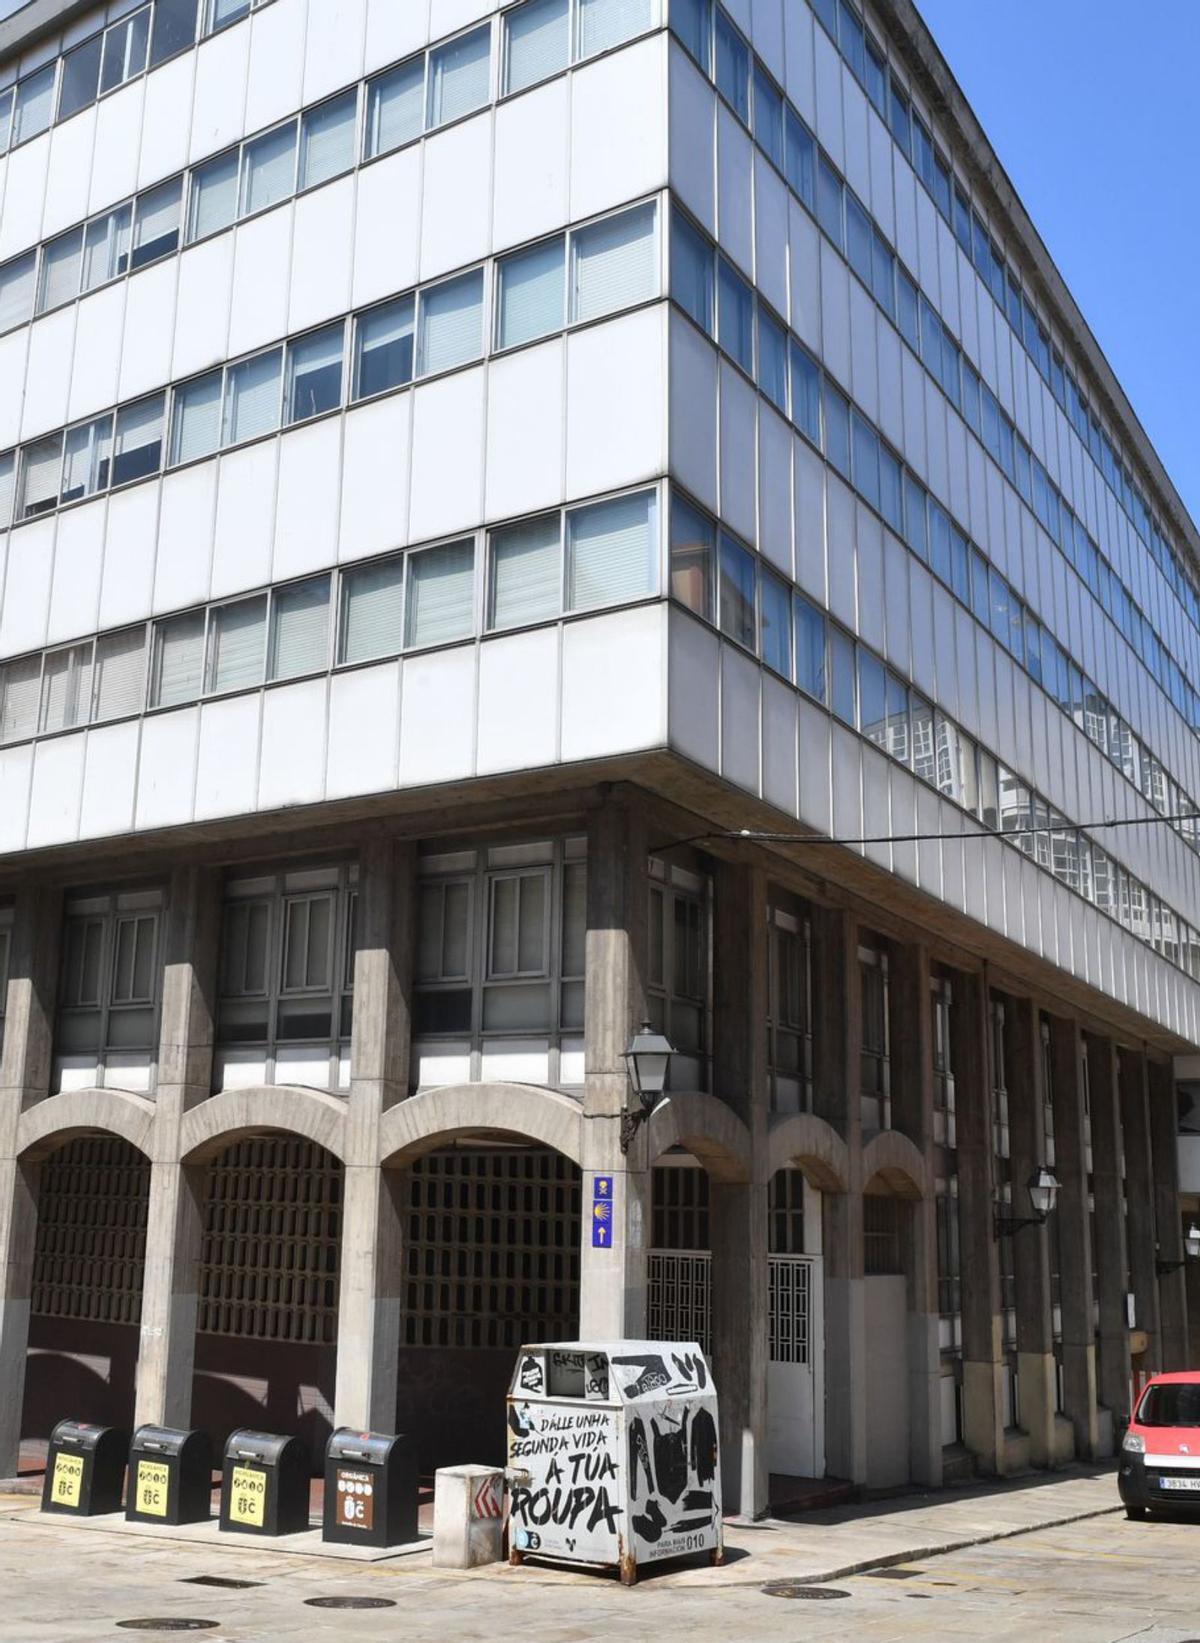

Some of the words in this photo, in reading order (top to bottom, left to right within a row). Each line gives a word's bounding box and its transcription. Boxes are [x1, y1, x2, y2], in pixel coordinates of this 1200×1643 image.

[540, 1413, 574, 1432] DÁLLE
[576, 1414, 610, 1427] UNHA
[509, 1436, 569, 1458] SEGUNDA
[572, 1430, 608, 1449] VIDA
[510, 1486, 624, 1534] ROUPA
[686, 1533, 705, 1550] 010
